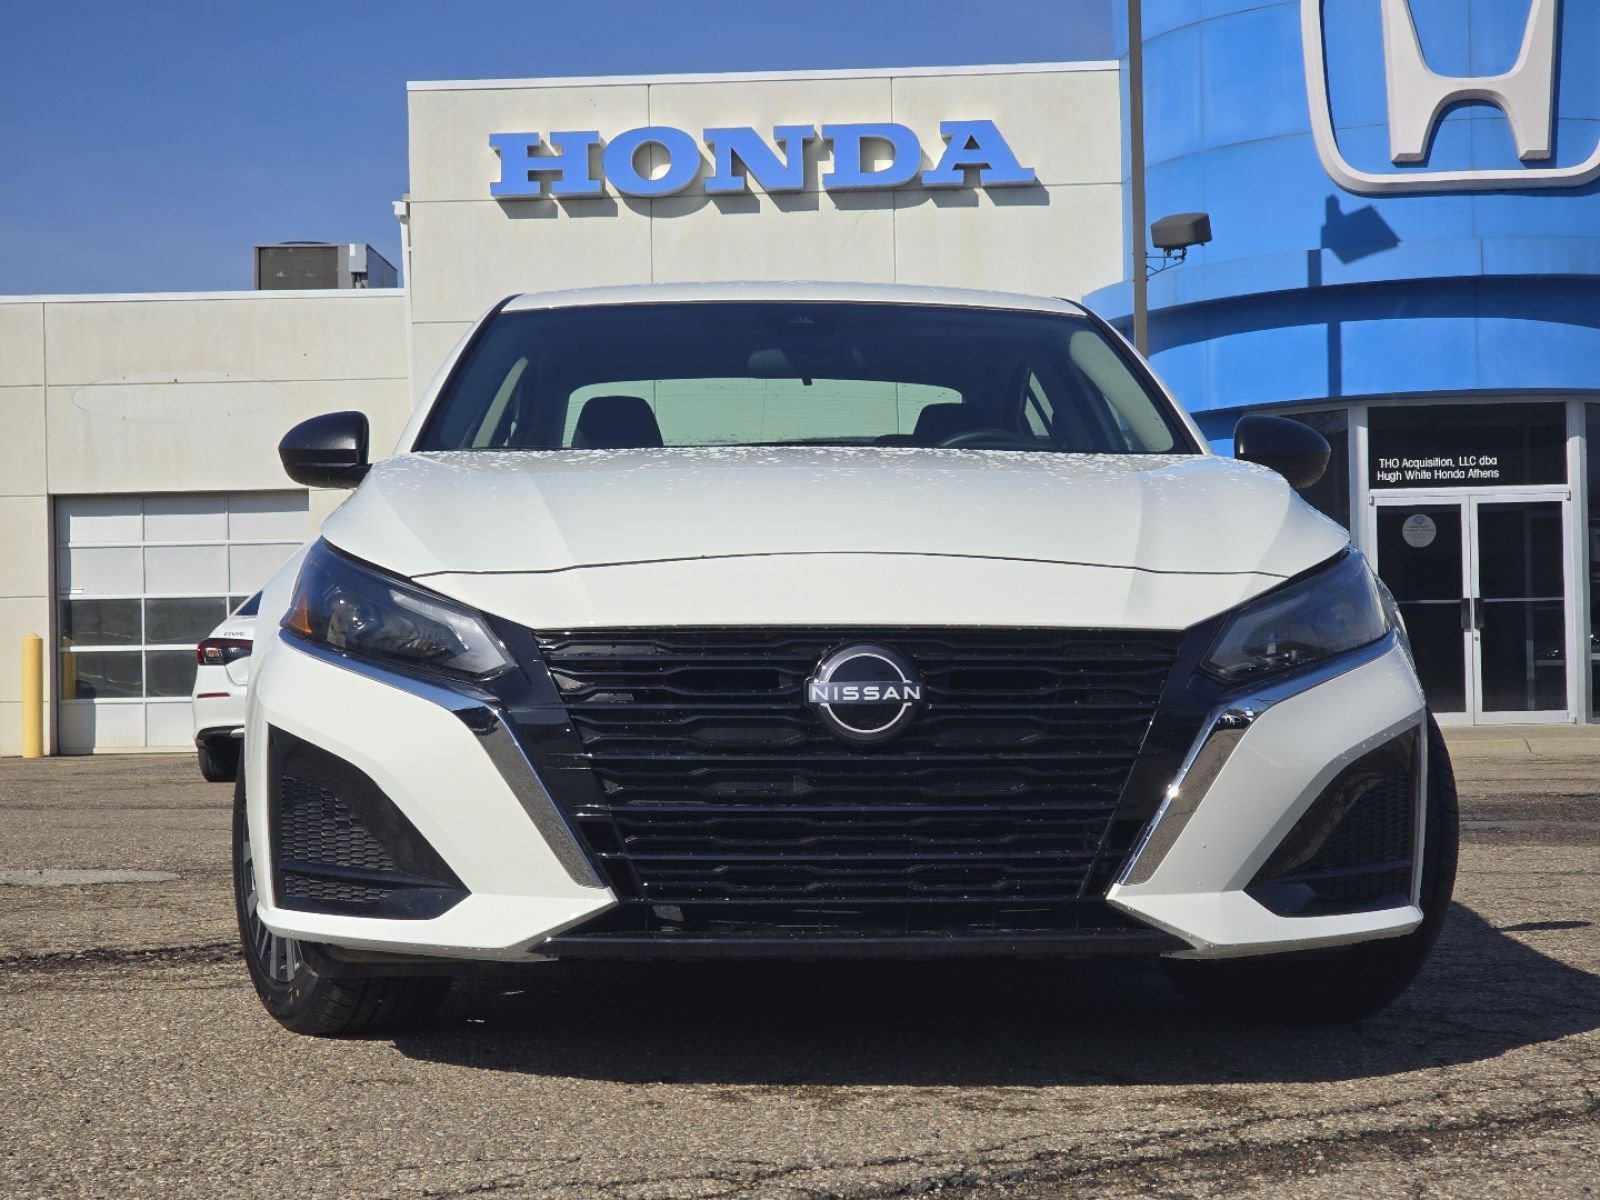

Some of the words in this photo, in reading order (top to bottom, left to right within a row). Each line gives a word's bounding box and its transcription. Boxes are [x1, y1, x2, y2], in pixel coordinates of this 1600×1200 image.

[489, 120, 1036, 199] HONDA
[1379, 458, 1400, 469] THO
[1459, 456, 1477, 467] LLC
[1478, 455, 1498, 466] dba
[1377, 471, 1402, 483] Hugh
[1404, 470, 1432, 480] White
[1434, 469, 1465, 480] Honda
[1467, 468, 1500, 479] Athens
[811, 686, 921, 701] NISSAN
